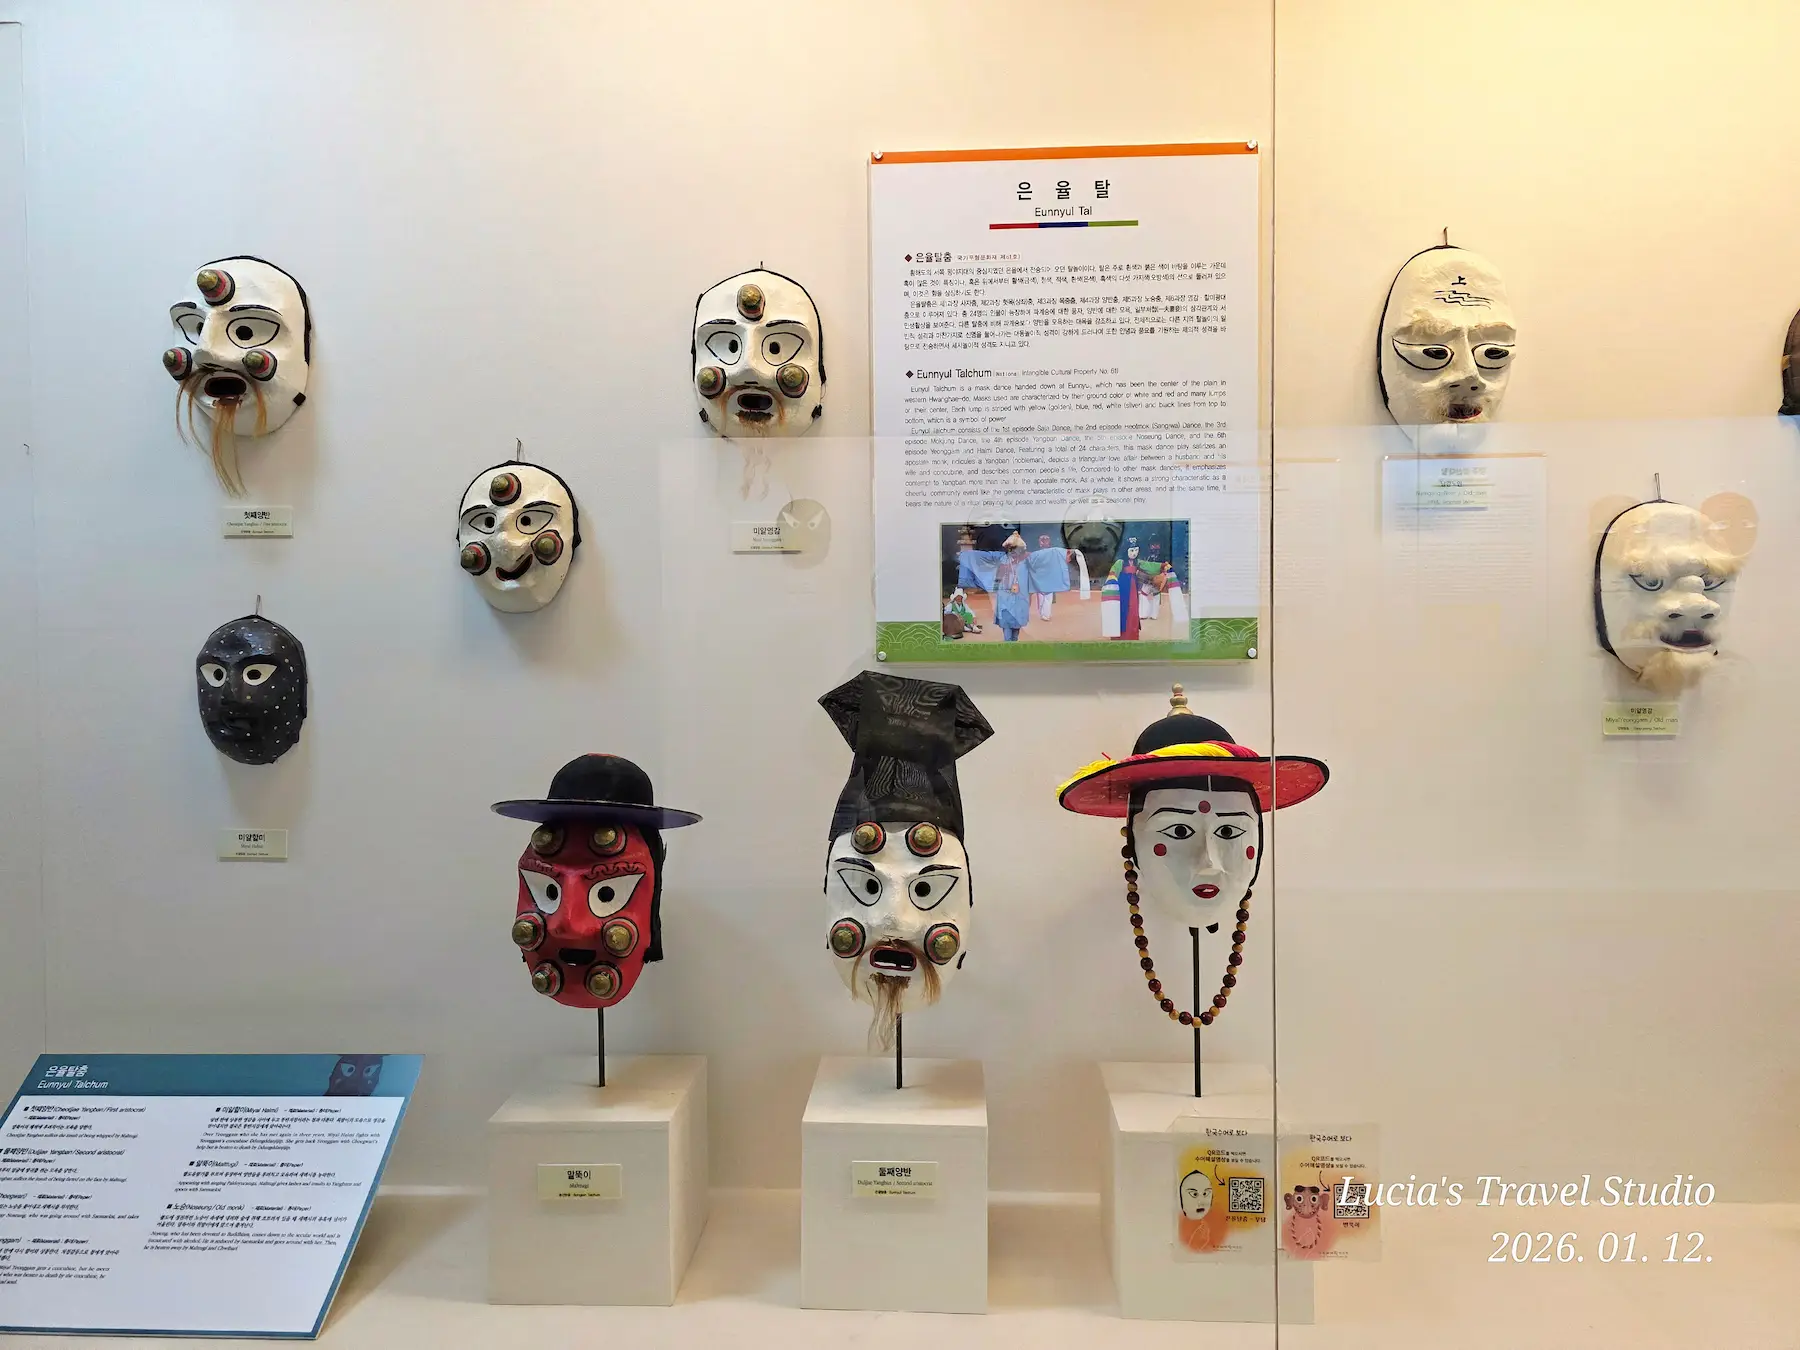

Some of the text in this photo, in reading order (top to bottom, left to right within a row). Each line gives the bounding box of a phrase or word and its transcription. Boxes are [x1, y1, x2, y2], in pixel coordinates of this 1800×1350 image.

[1016, 179, 1111, 200] 은 율 탈
[1034, 206, 1092, 218] Eunnyul Tal
[916, 252, 952, 262] 은율탈춤
[917, 370, 952, 380] Eunnyul
[956, 368, 992, 378] Talchum
[244, 511, 271, 520] 첫째양반
[753, 527, 781, 535] 미얄영감
[44, 1064, 89, 1077] 은율탈춤
[37, 1080, 109, 1090] Eunnyul Talchum
[1206, 1128, 1234, 1136] 한국수어로
[567, 1170, 592, 1180] 말뚝이
[878, 1167, 912, 1177] 둘째양반
